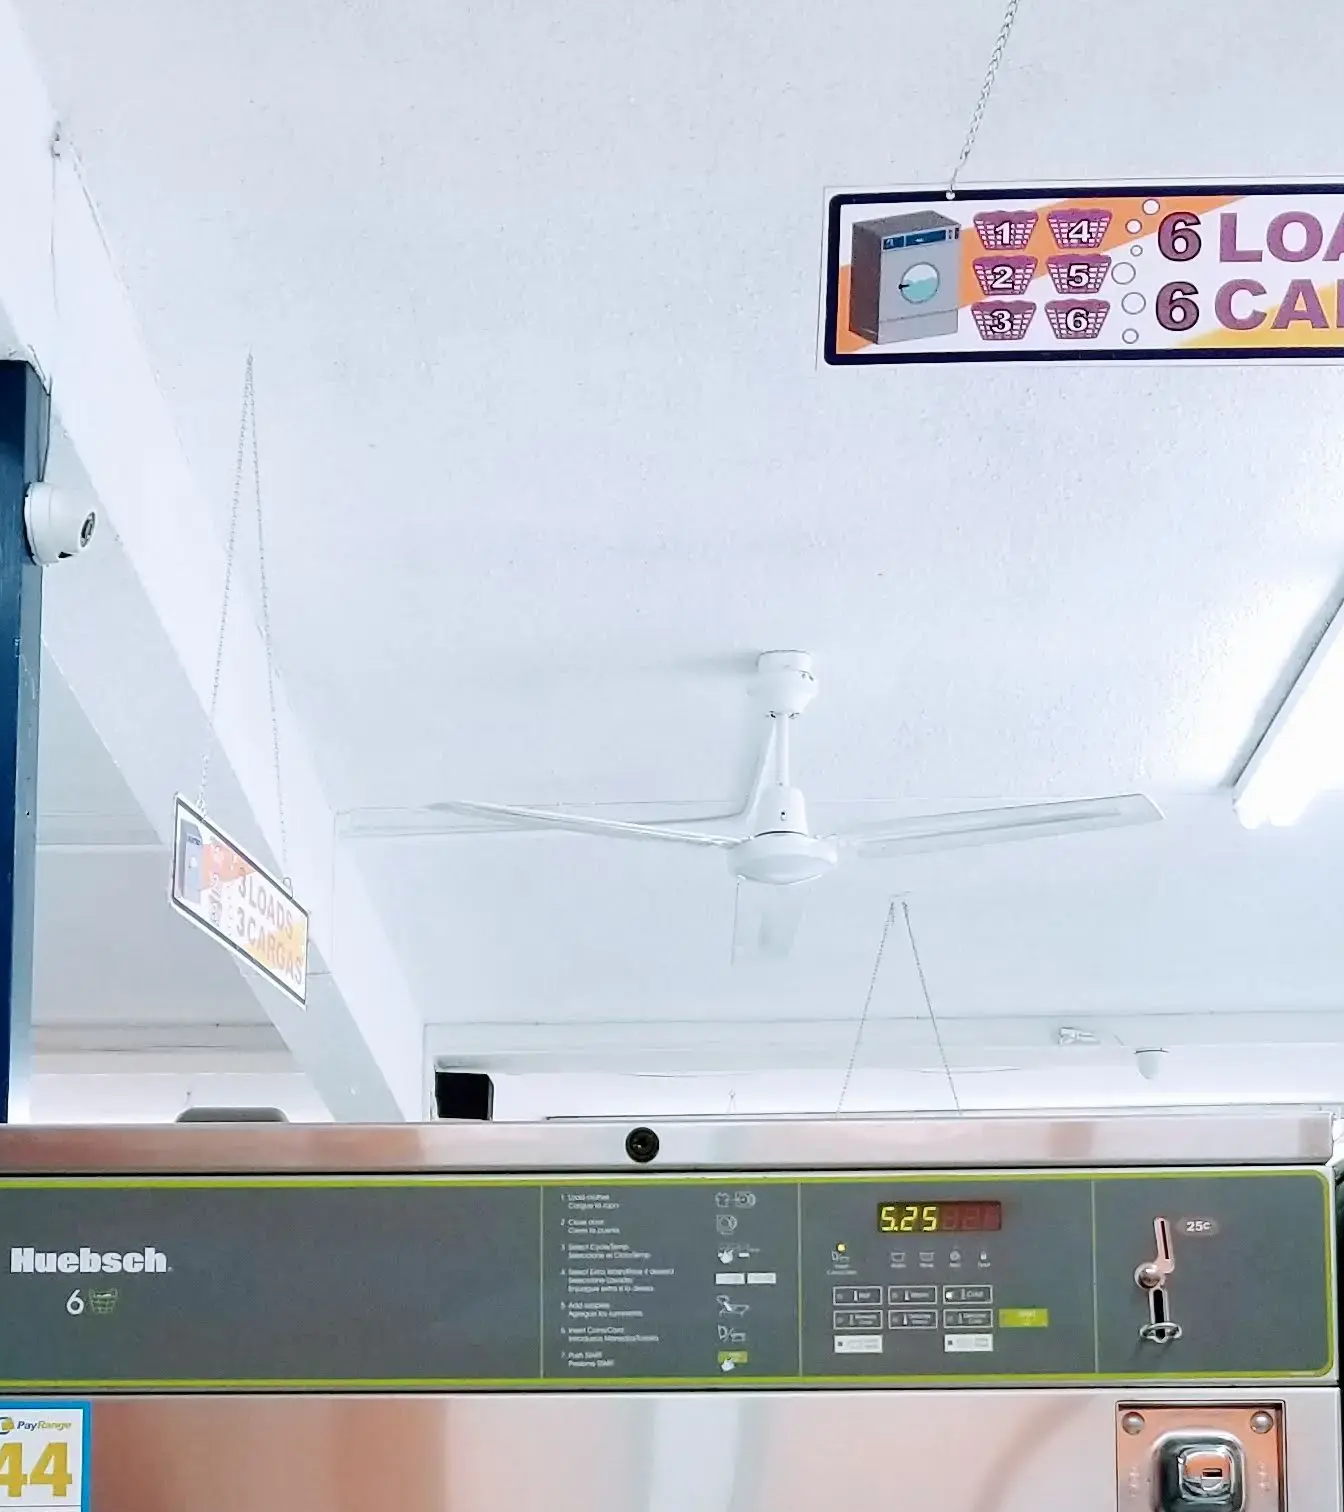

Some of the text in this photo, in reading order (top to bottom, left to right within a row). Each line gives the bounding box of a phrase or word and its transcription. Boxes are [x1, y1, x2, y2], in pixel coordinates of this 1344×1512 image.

[995, 221, 1012, 245] 1
[1068, 219, 1092, 243] 4
[1157, 211, 1203, 264] 6
[992, 265, 1014, 289] 2
[1067, 264, 1090, 287] 5
[1155, 281, 1201, 332] 6
[991, 310, 1012, 333] 3
[1065, 308, 1089, 332] 6
[238, 867, 294, 940] 3 LOADS
[236, 907, 303, 986] 3 CARGAS
[879, 1206, 938, 1232] 5.25
[10, 1247, 168, 1273] Huebsch
[66, 1289, 85, 1315] 6
[17, 1420, 73, 1431] PayRange
